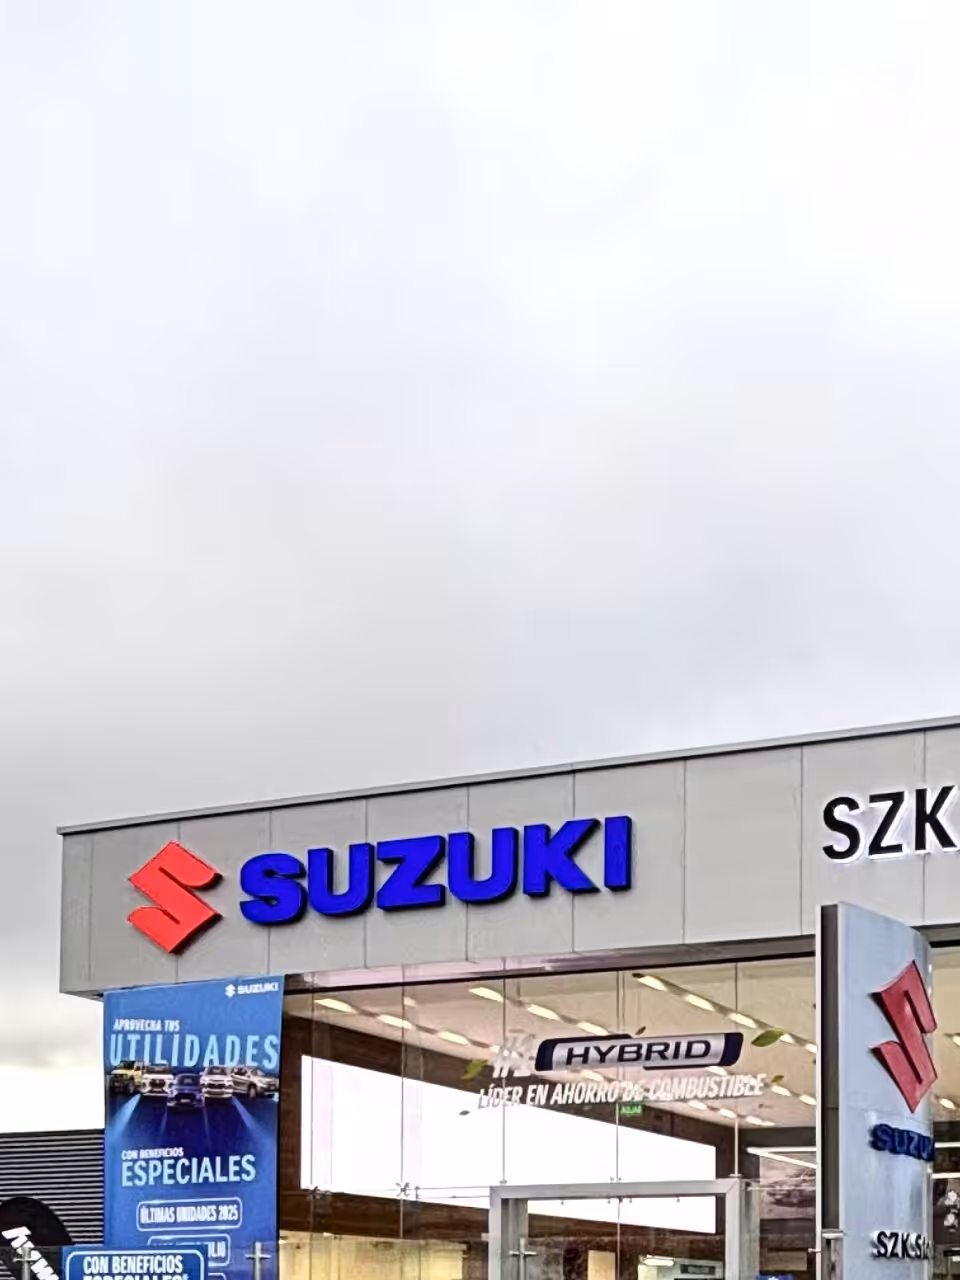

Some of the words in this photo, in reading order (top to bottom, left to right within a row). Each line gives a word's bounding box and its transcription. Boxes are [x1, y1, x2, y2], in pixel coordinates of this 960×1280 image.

[822, 785, 959, 861] SZK
[240, 815, 632, 925] SUZUKI
[237, 982, 279, 995] SUZUKI
[113, 1018, 162, 1031] APROVECHA
[164, 1018, 181, 1032] TUS
[109, 1033, 280, 1070] UTILIDADES
[565, 1039, 712, 1066] HYBRID
[478, 1083, 523, 1109] LÍDER
[526, 1084, 549, 1105] EN
[550, 1080, 620, 1105] AHORRO
[648, 1074, 767, 1101] COMBUSTIBLE
[121, 1150, 138, 1161] CON
[139, 1147, 184, 1159] BENEFICIOS
[869, 1123, 934, 1162] SUZU
[121, 1154, 257, 1187] ESPECIALES
[140, 1205, 175, 1224] ÚLTIMAS
[176, 1205, 217, 1222] UNIDADES
[218, 1204, 239, 1221] 2025
[874, 1230, 911, 1260] SZK
[83, 1256, 109, 1274] CON
[112, 1255, 183, 1274] BENEFICIOS
